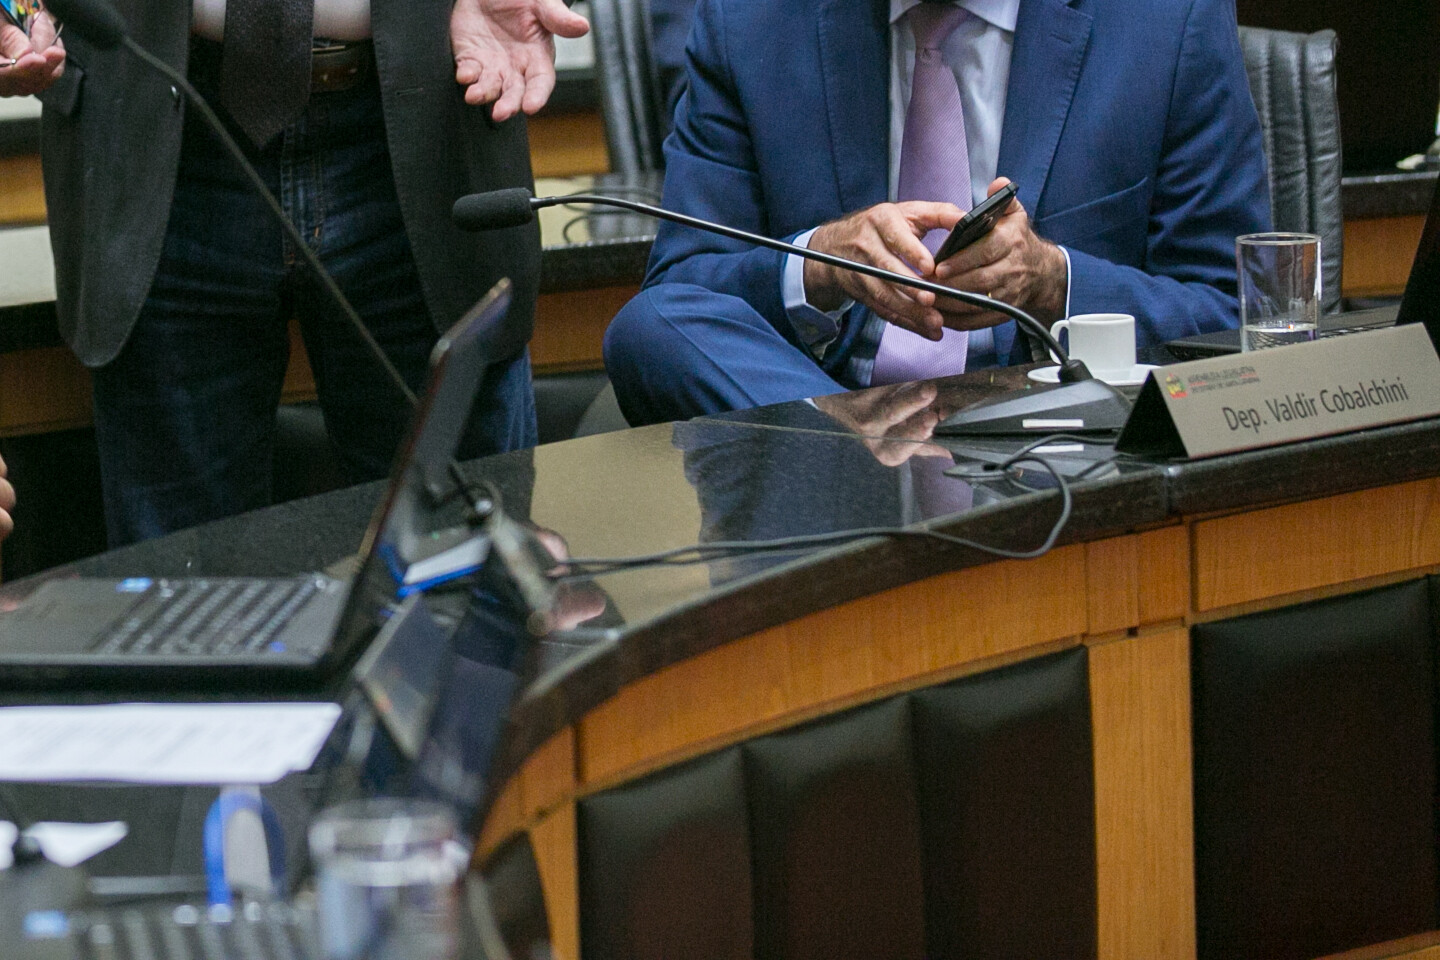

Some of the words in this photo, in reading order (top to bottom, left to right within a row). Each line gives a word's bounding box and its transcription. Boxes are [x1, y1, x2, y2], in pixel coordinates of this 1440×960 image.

[1221, 406, 1268, 434] Dep.
[1265, 392, 1319, 424] Valdir
[1319, 376, 1410, 414] Cobalchini
